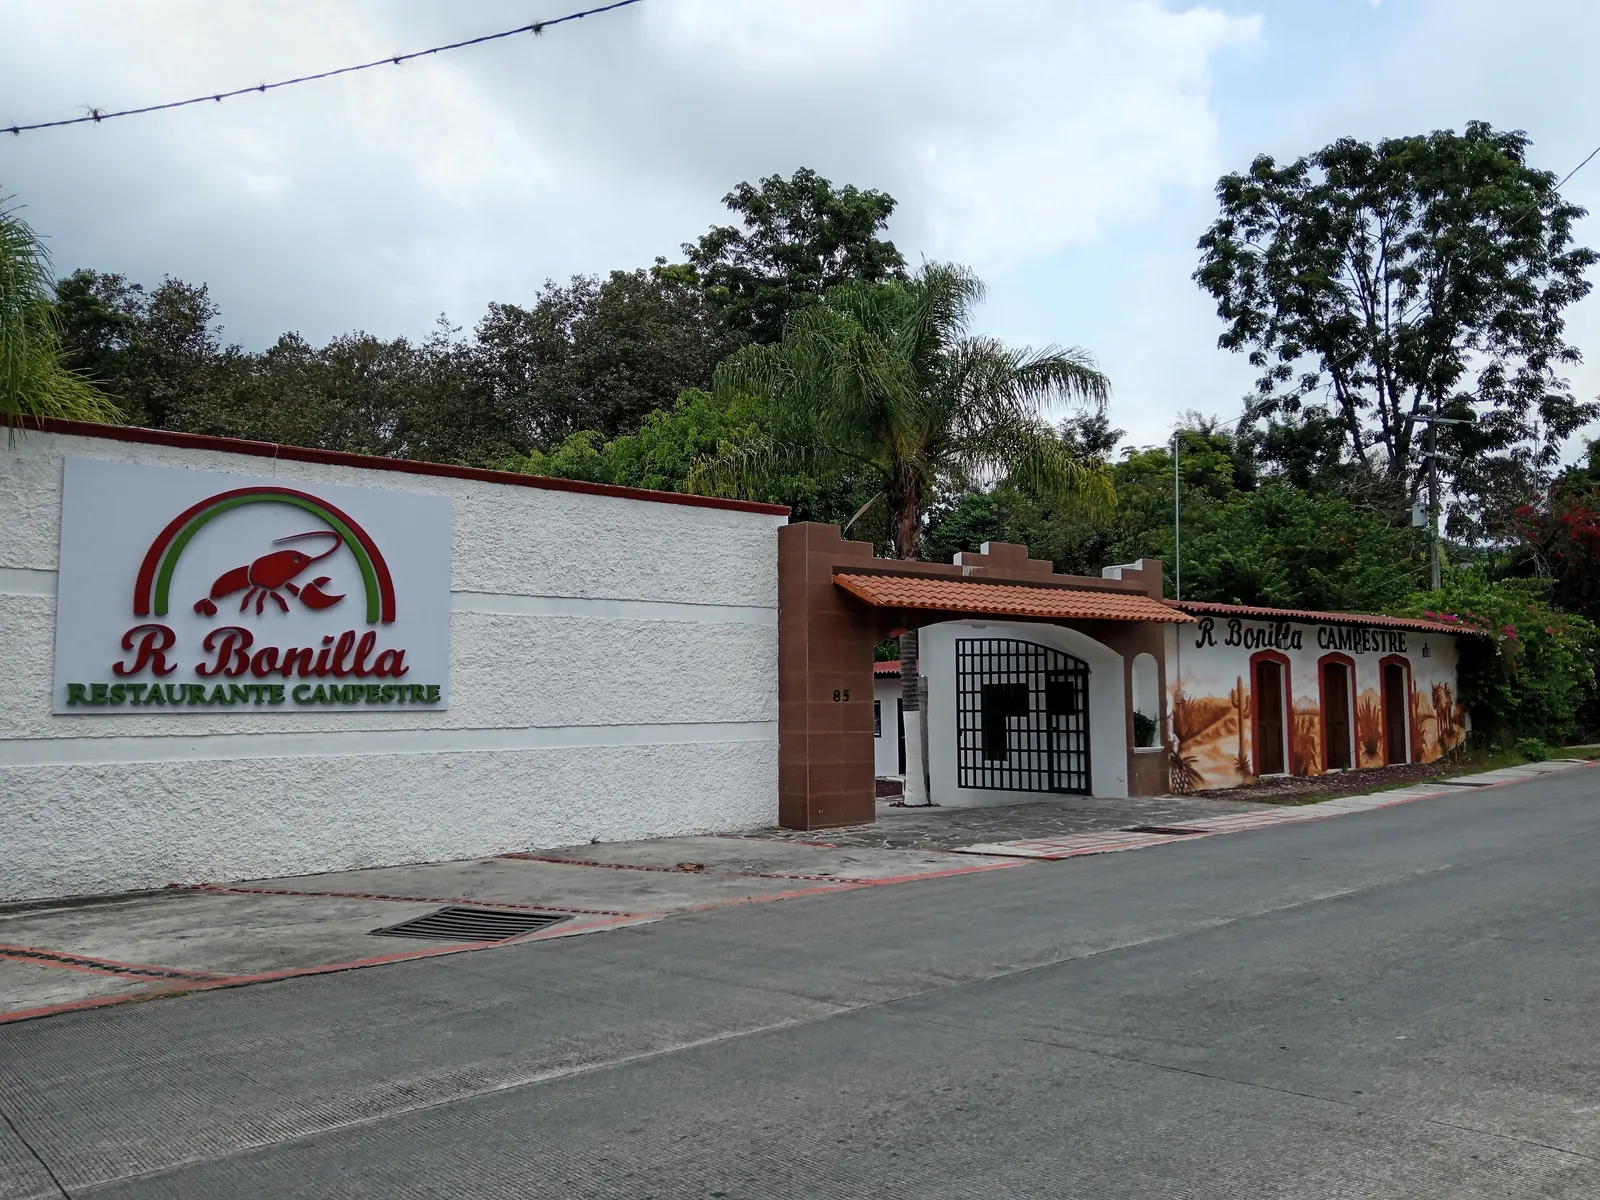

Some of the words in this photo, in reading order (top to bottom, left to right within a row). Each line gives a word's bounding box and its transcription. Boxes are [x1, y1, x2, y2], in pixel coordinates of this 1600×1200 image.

[1225, 618, 1303, 650] Bonilla
[1317, 626, 1407, 653] CAMPESTRE
[112, 623, 177, 676] R
[194, 626, 409, 678] Bonilla
[66, 683, 285, 706] RESTAURANTE
[292, 683, 441, 704] CAMPESTRE
[833, 689, 850, 702] 85
